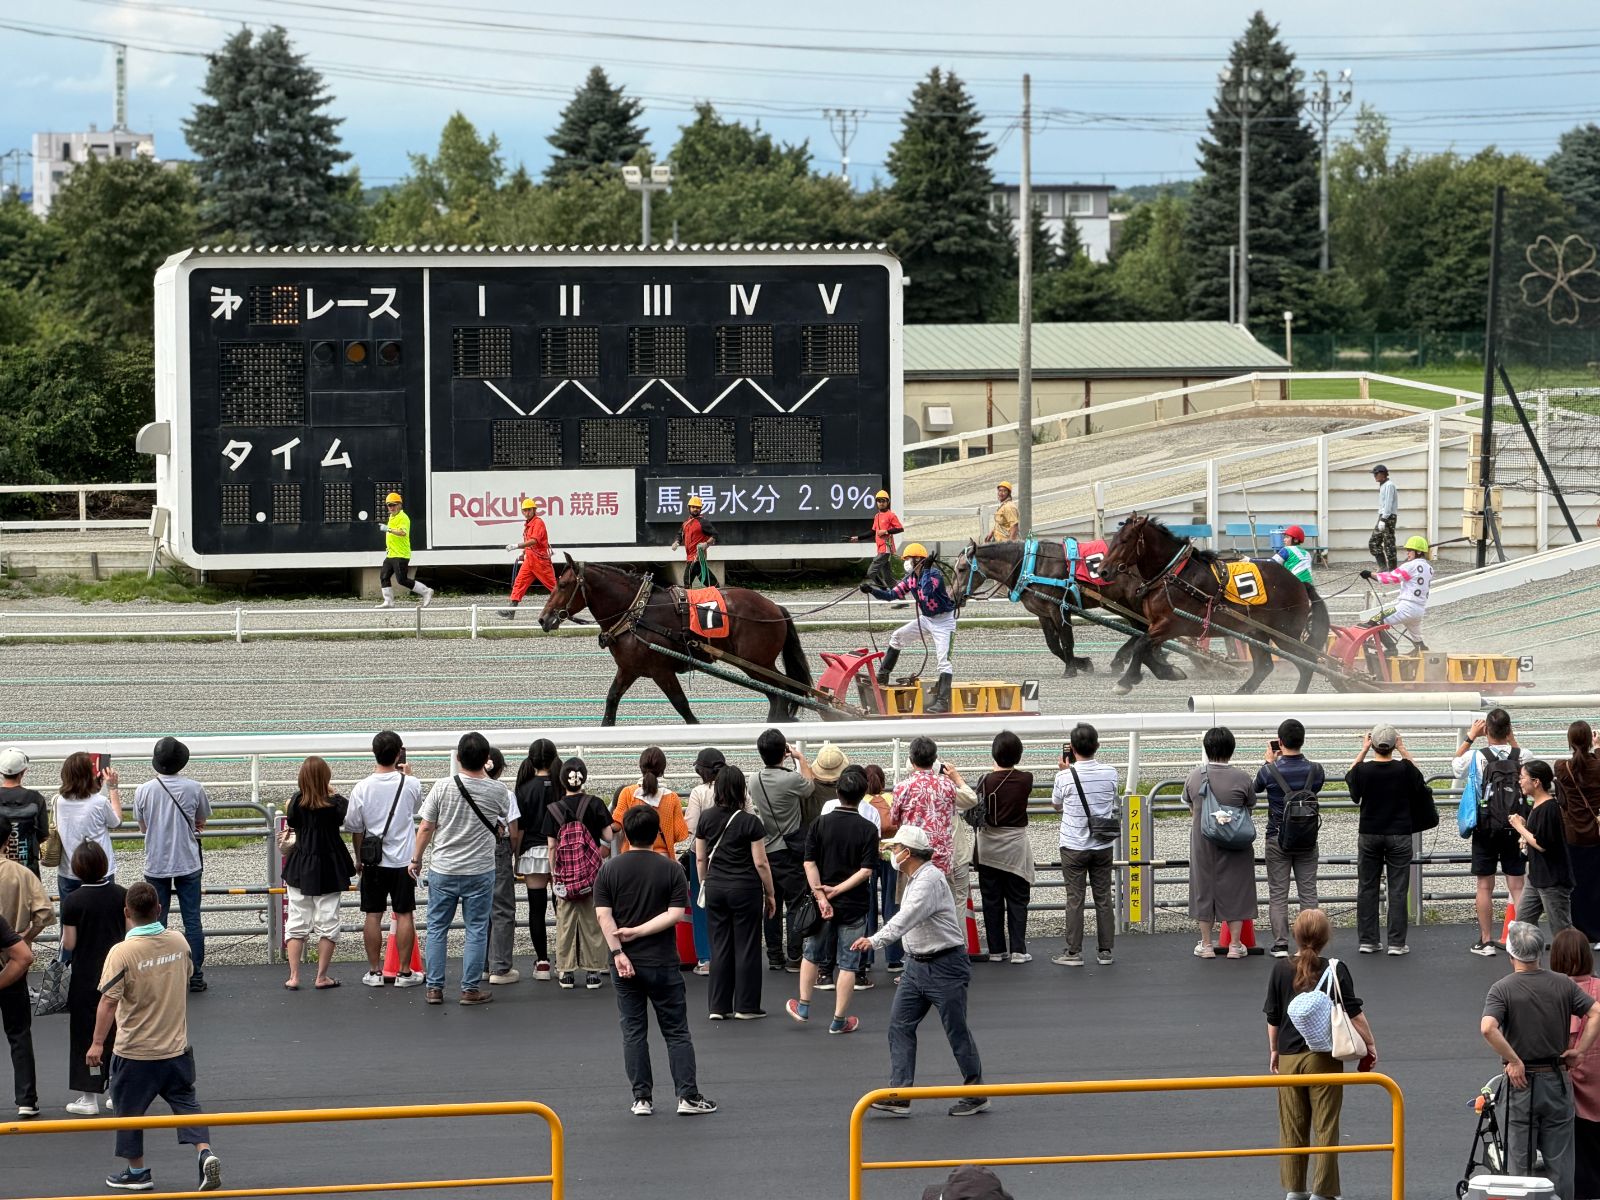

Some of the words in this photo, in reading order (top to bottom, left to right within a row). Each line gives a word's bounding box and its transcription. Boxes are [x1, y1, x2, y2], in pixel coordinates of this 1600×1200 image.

[569, 491, 619, 517] 競馬
[656, 484, 781, 516] 馬場水分
[798, 483, 876, 511] 2.9%
[1233, 571, 1259, 600] 5
[696, 600, 718, 629] 7
[1519, 655, 1533, 672] 5
[1025, 680, 1039, 700] 7
[1130, 809, 1140, 907] タバコは煙所で
